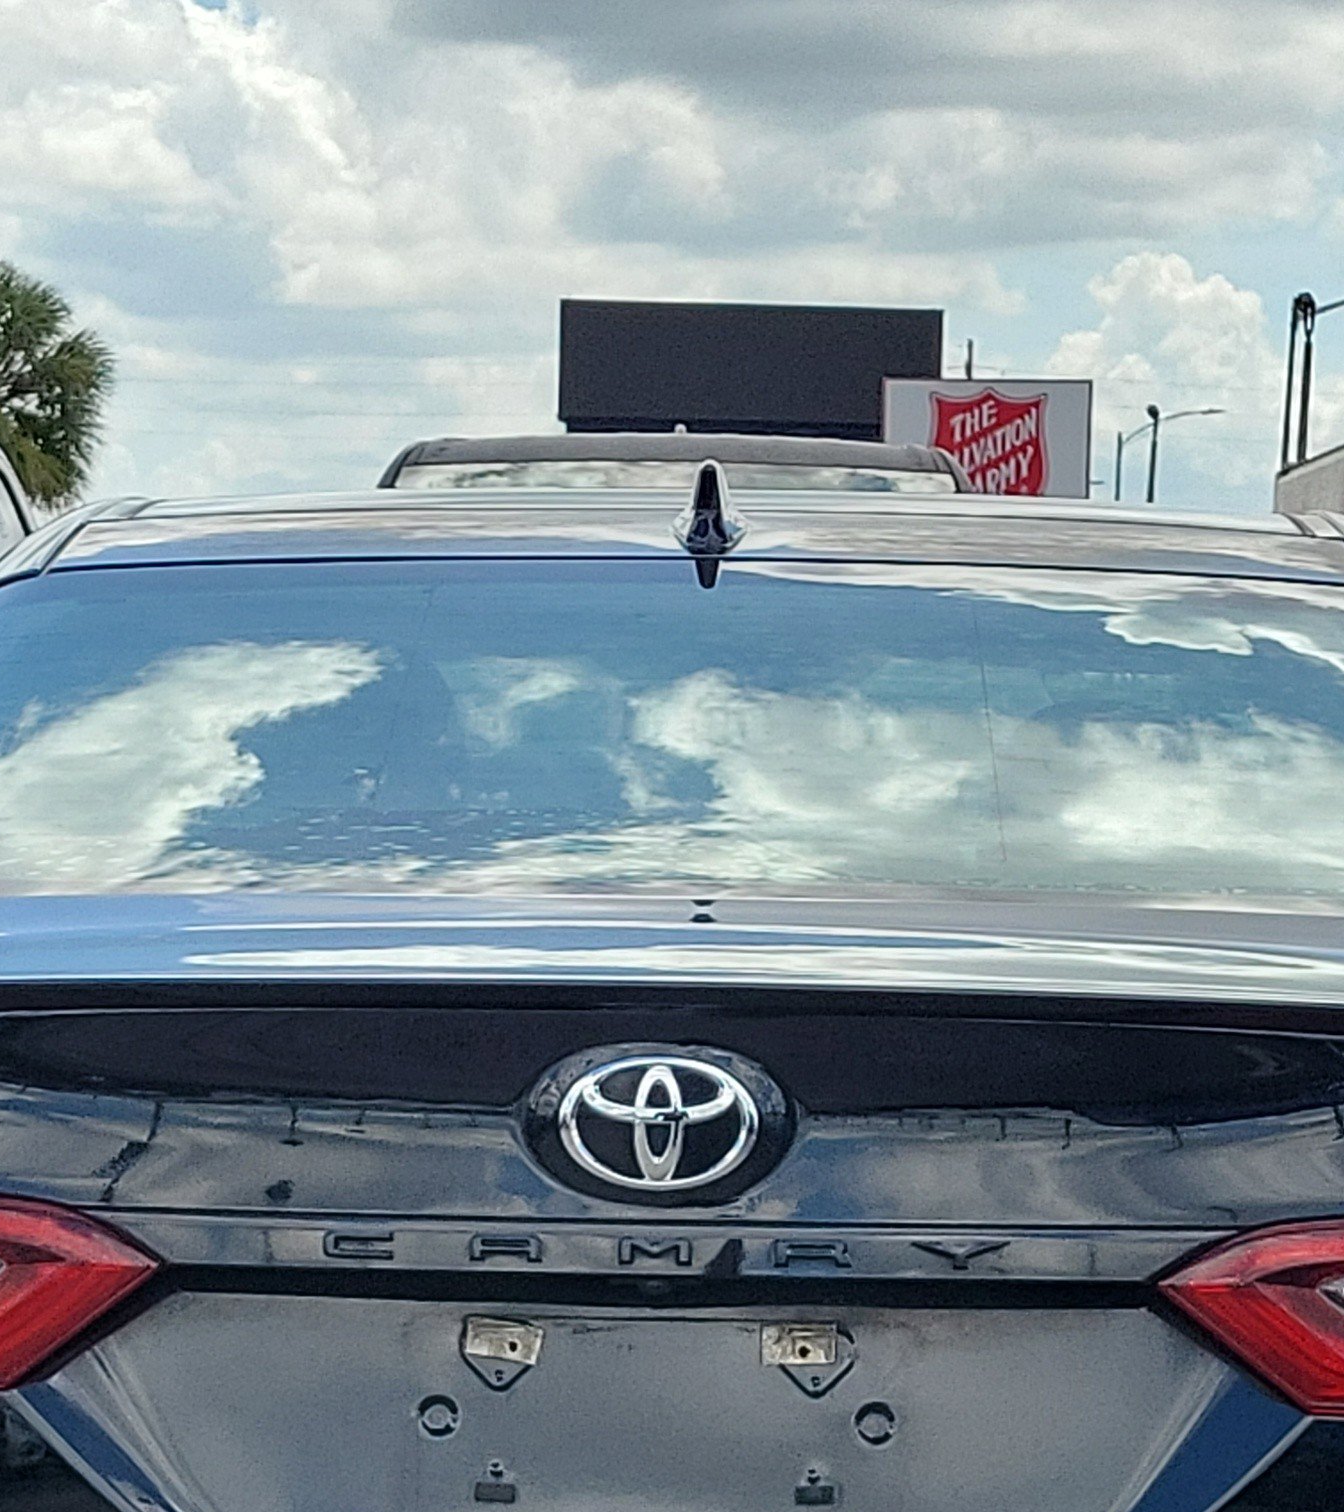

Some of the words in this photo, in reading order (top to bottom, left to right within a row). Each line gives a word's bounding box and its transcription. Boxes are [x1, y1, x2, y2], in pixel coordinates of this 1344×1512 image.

[949, 400, 998, 444] THE
[953, 405, 1038, 474] LVATION
[322, 1229, 1010, 1271] CAMRY
